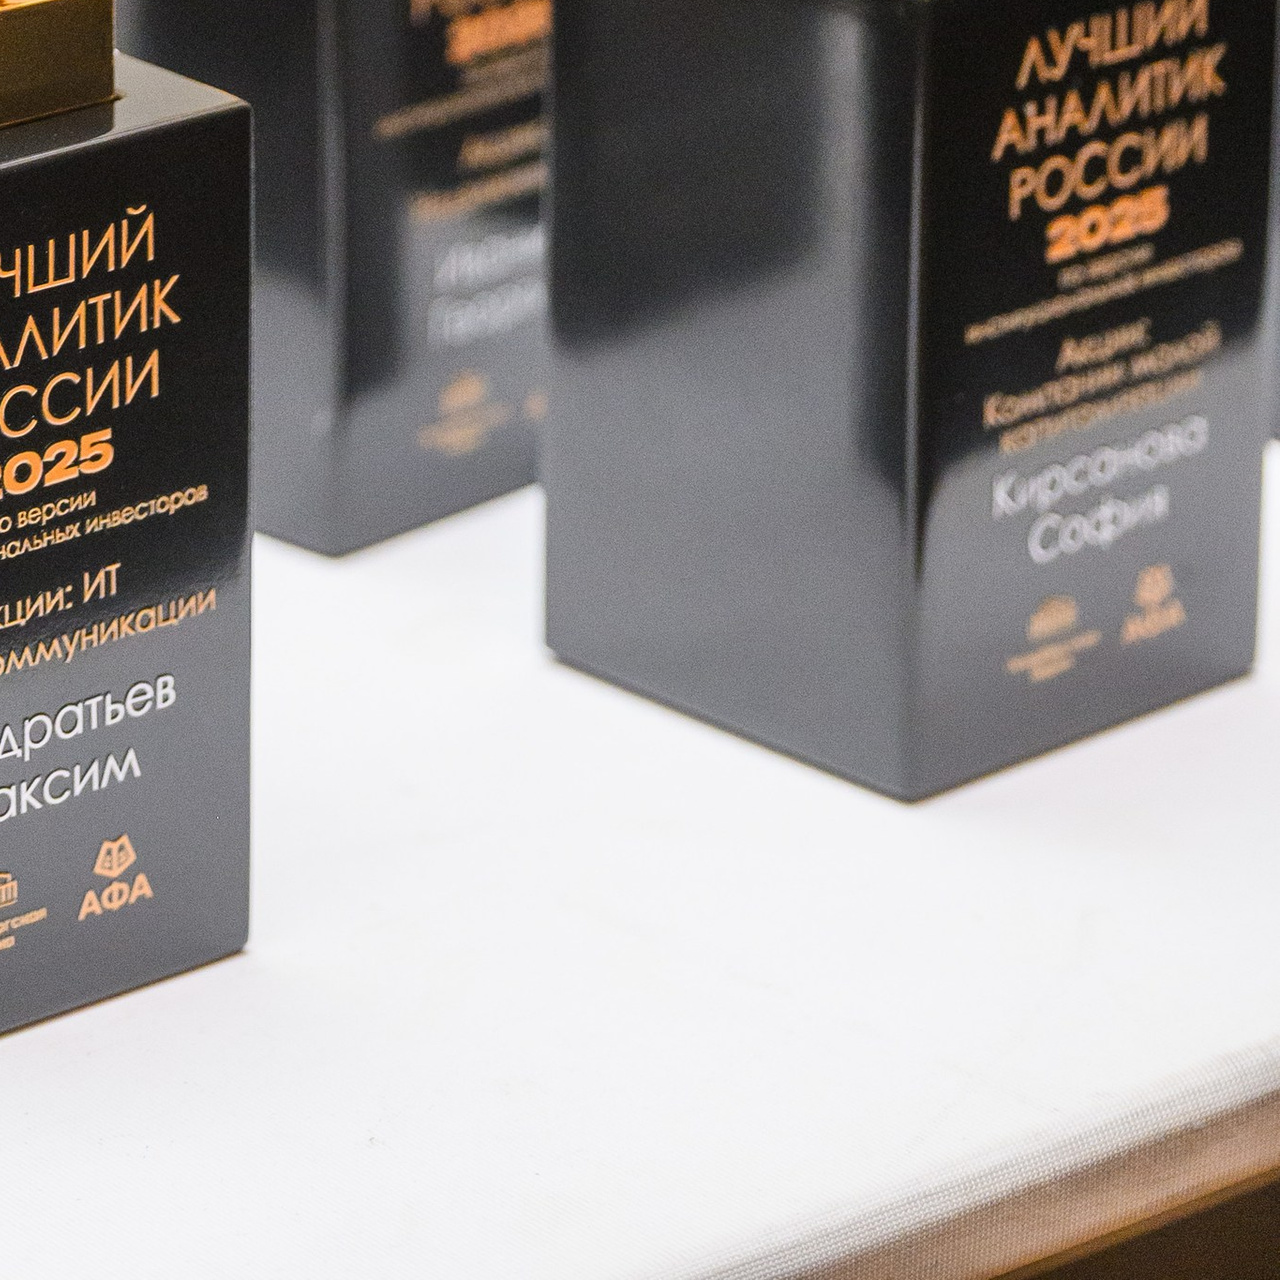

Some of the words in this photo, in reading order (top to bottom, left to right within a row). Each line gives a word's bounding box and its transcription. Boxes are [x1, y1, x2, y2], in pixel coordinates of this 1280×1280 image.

[990, 42, 1228, 163] АНАЛИТИК
[1008, 112, 1209, 221] РОССИИ
[1045, 184, 1170, 265] 2025
[992, 414, 1210, 520] Кирсанова
[17, 490, 97, 529] версии
[85, 484, 209, 535] инвесторов
[1027, 483, 1170, 565] София
[83, 562, 122, 604] ИТ
[77, 872, 155, 921] АФА
